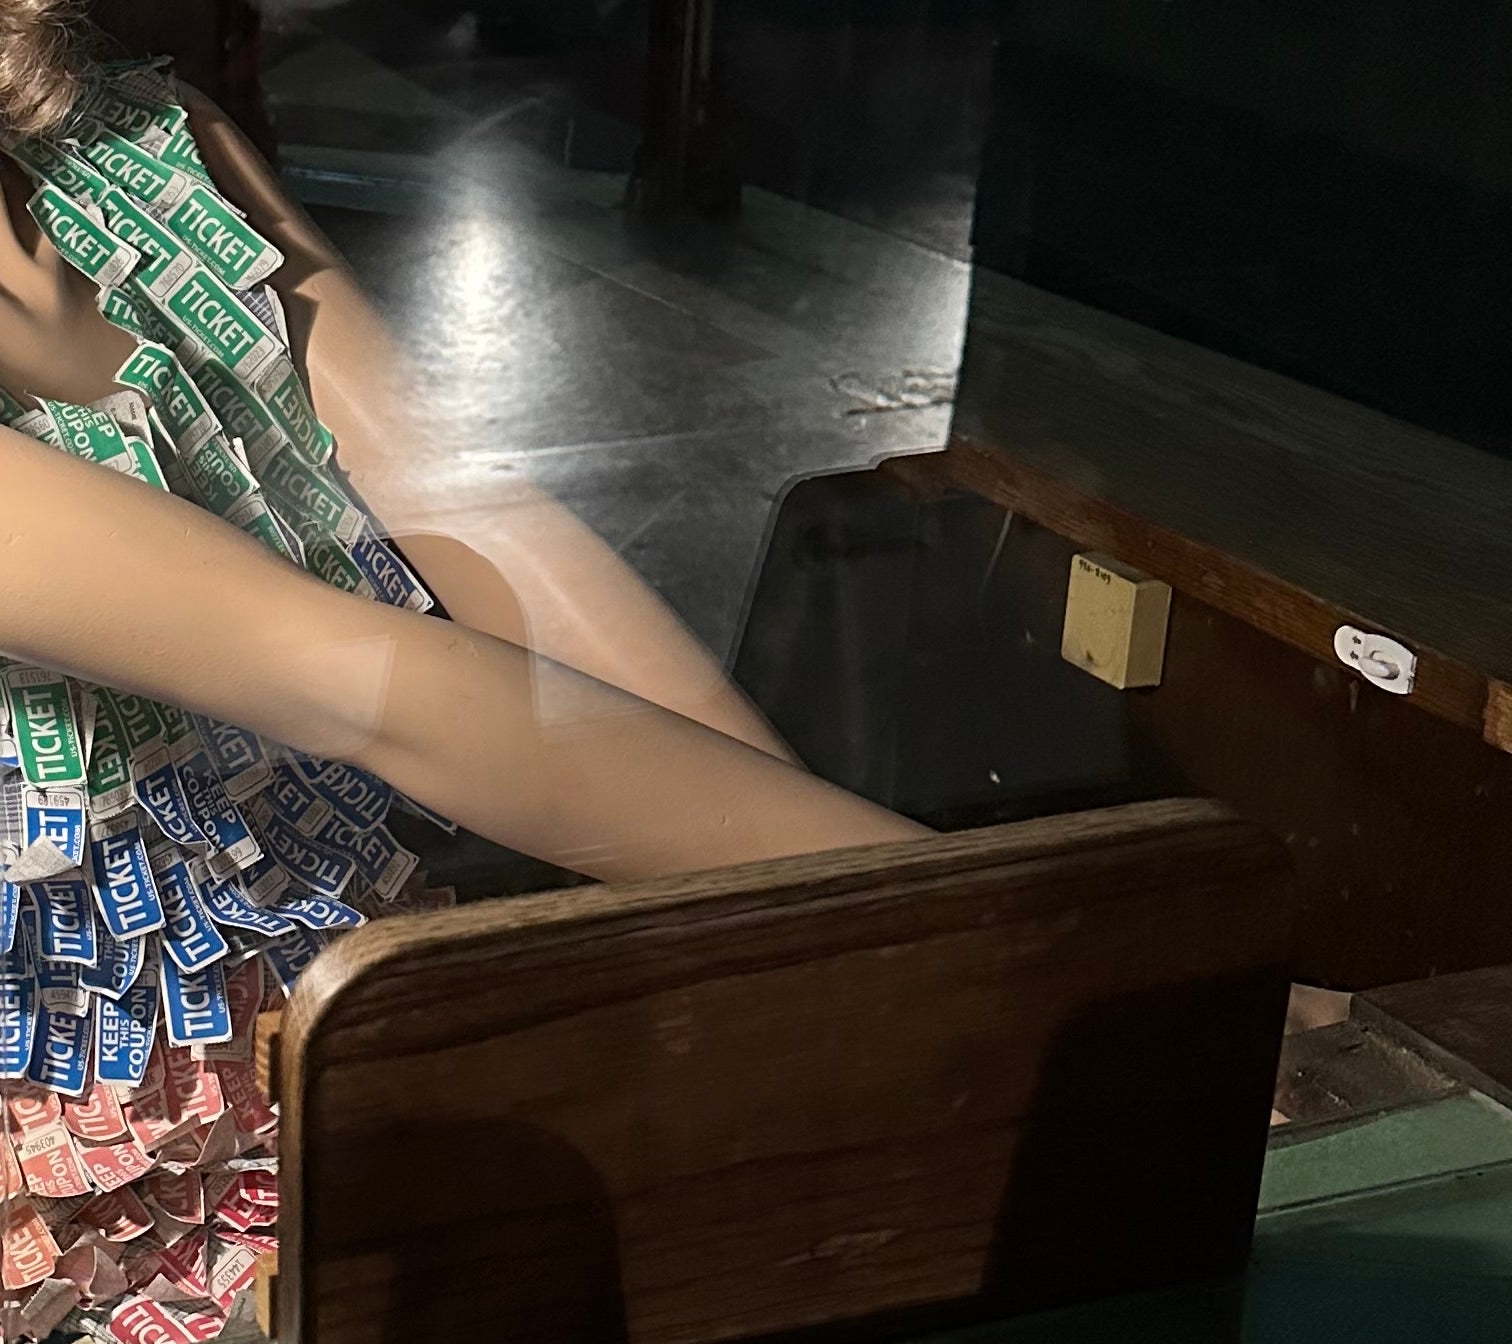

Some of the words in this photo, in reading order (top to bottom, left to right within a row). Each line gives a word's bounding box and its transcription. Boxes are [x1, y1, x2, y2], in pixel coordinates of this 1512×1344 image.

[89, 140, 167, 196] TICKET
[172, 130, 205, 167] TIC
[39, 198, 111, 267] TICKET
[104, 197, 174, 273] TICKET
[179, 197, 256, 272] TICKET
[112, 295, 142, 326] TIC
[180, 279, 255, 356] TICKET
[132, 356, 198, 429] TICKET
[197, 366, 266, 441] TICKET
[47, 401, 75, 452] US-TICKET.CO
[58, 405, 98, 463] UPON
[205, 449, 241, 497] COUP
[270, 459, 343, 522] TICKET
[356, 535, 409, 606] TICKET
[23, 689, 67, 780] TICKET
[210, 718, 256, 769] KET
[146, 775, 194, 843] ICKET
[203, 768, 238, 825] KEEP
[273, 767, 311, 813] KET
[136, 841, 156, 902] US-TICKET.COM
[267, 825, 338, 885] TICKET
[325, 818, 390, 869] ICKET
[101, 836, 147, 931] TICKET
[207, 878, 282, 931] TICKET
[288, 897, 350, 926] TICK
[44, 882, 83, 954] TICKET
[158, 873, 211, 963] TICKET
[111, 939, 130, 991] COUP
[102, 1001, 119, 1062] KEEP
[119, 1018, 130, 1049] THIS
[129, 988, 147, 1079] COUPON
[178, 973, 214, 1037] TICK
[40, 1014, 78, 1081] TICKE
[14, 1097, 47, 1133] TIC
[73, 1095, 109, 1134] TIC
[169, 1053, 209, 1120] TICKE
[25, 1136, 56, 1154] 403945
[93, 1163, 121, 1187] EEP
[9, 1225, 53, 1283] TICKE
[216, 1258, 246, 1290] 144355
